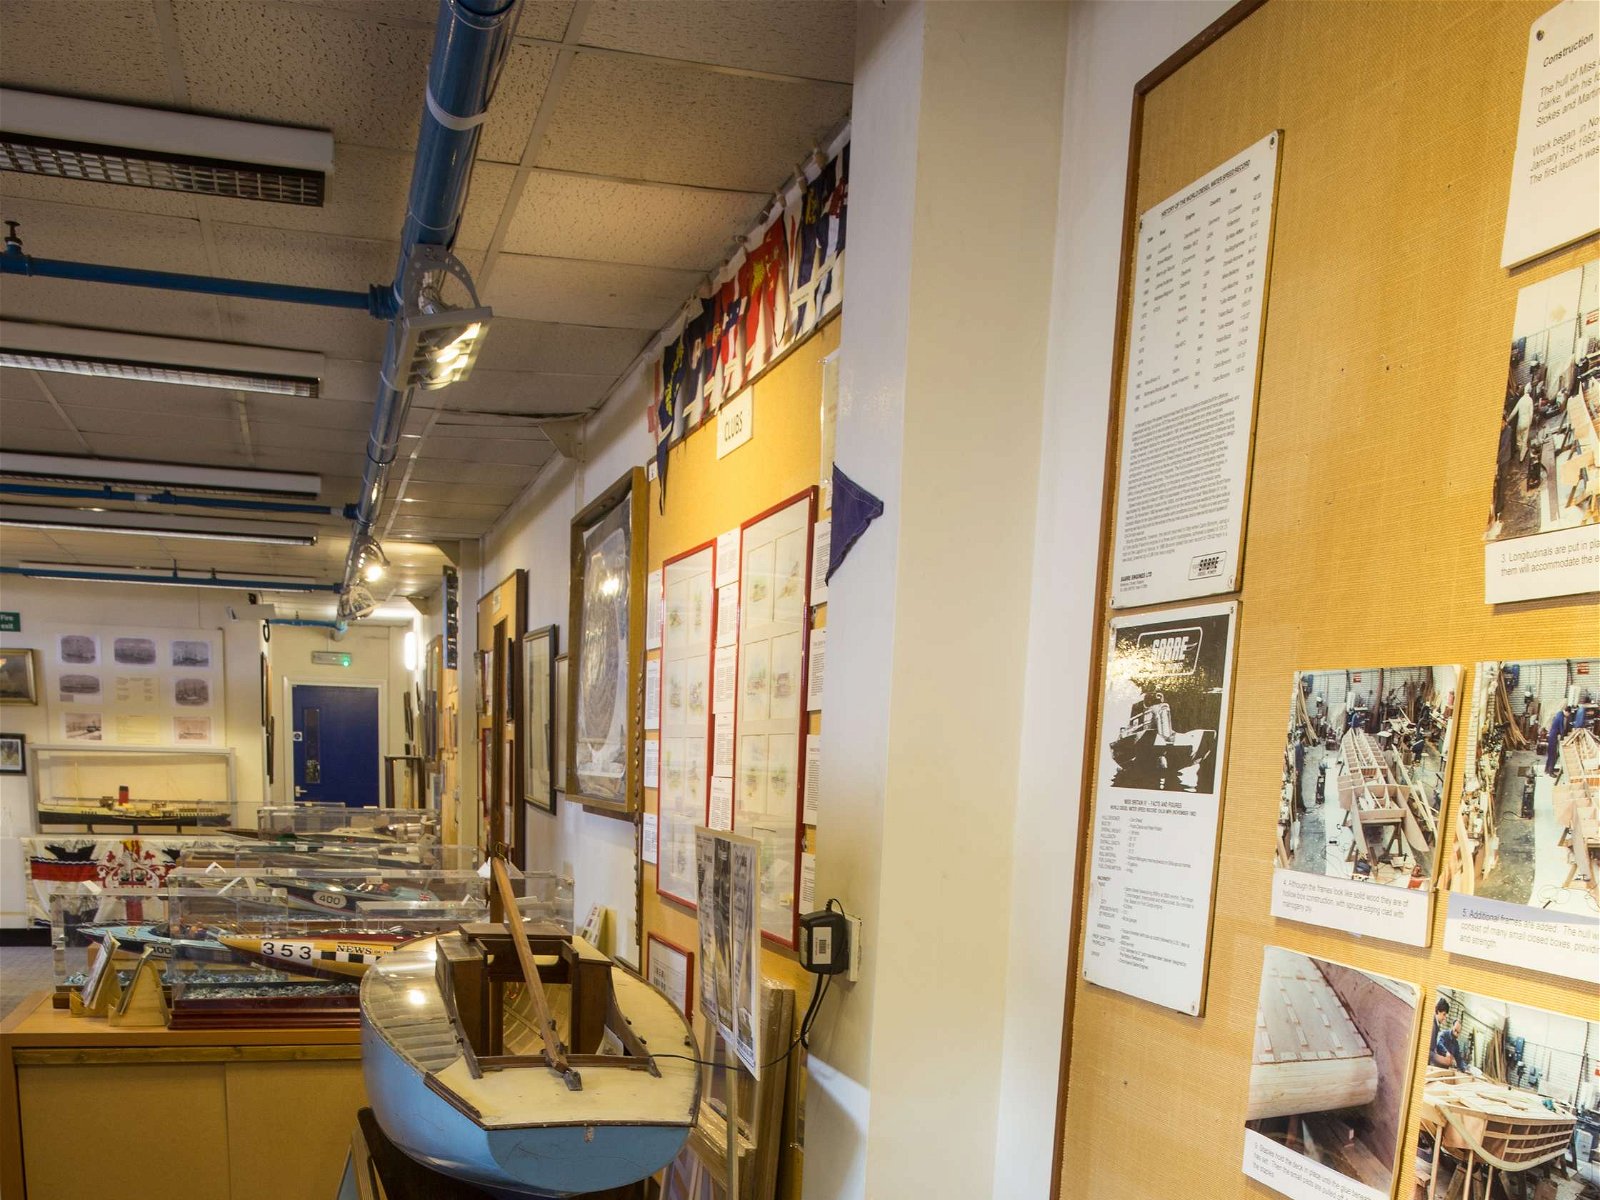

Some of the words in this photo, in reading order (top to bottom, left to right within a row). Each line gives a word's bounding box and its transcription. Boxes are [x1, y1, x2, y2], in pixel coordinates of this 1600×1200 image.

[1543, 33, 1592, 67] Construction
[1540, 84, 1553, 96] The
[1555, 74, 1568, 89] hull
[1570, 68, 1578, 80] of
[1579, 60, 1596, 75] Miss
[1565, 84, 1579, 97] with
[1581, 78, 1591, 87] his
[1536, 109, 1560, 127] Stokes
[1562, 100, 1575, 113] and
[1533, 141, 1550, 156] Work
[1552, 129, 1575, 146] began
[1579, 123, 1586, 132] in
[1530, 173, 1542, 182] The
[1544, 165, 1557, 176] first
[1559, 153, 1582, 170] launch
[1585, 145, 1598, 158] was
[725, 411, 743, 442] CLUBS
[1509, 548, 1552, 561] Longitudinals
[1531, 558, 1579, 571] accommodate
[320, 895, 340, 905] 400
[263, 942, 312, 960] 353
[336, 945, 372, 954] NEWS
